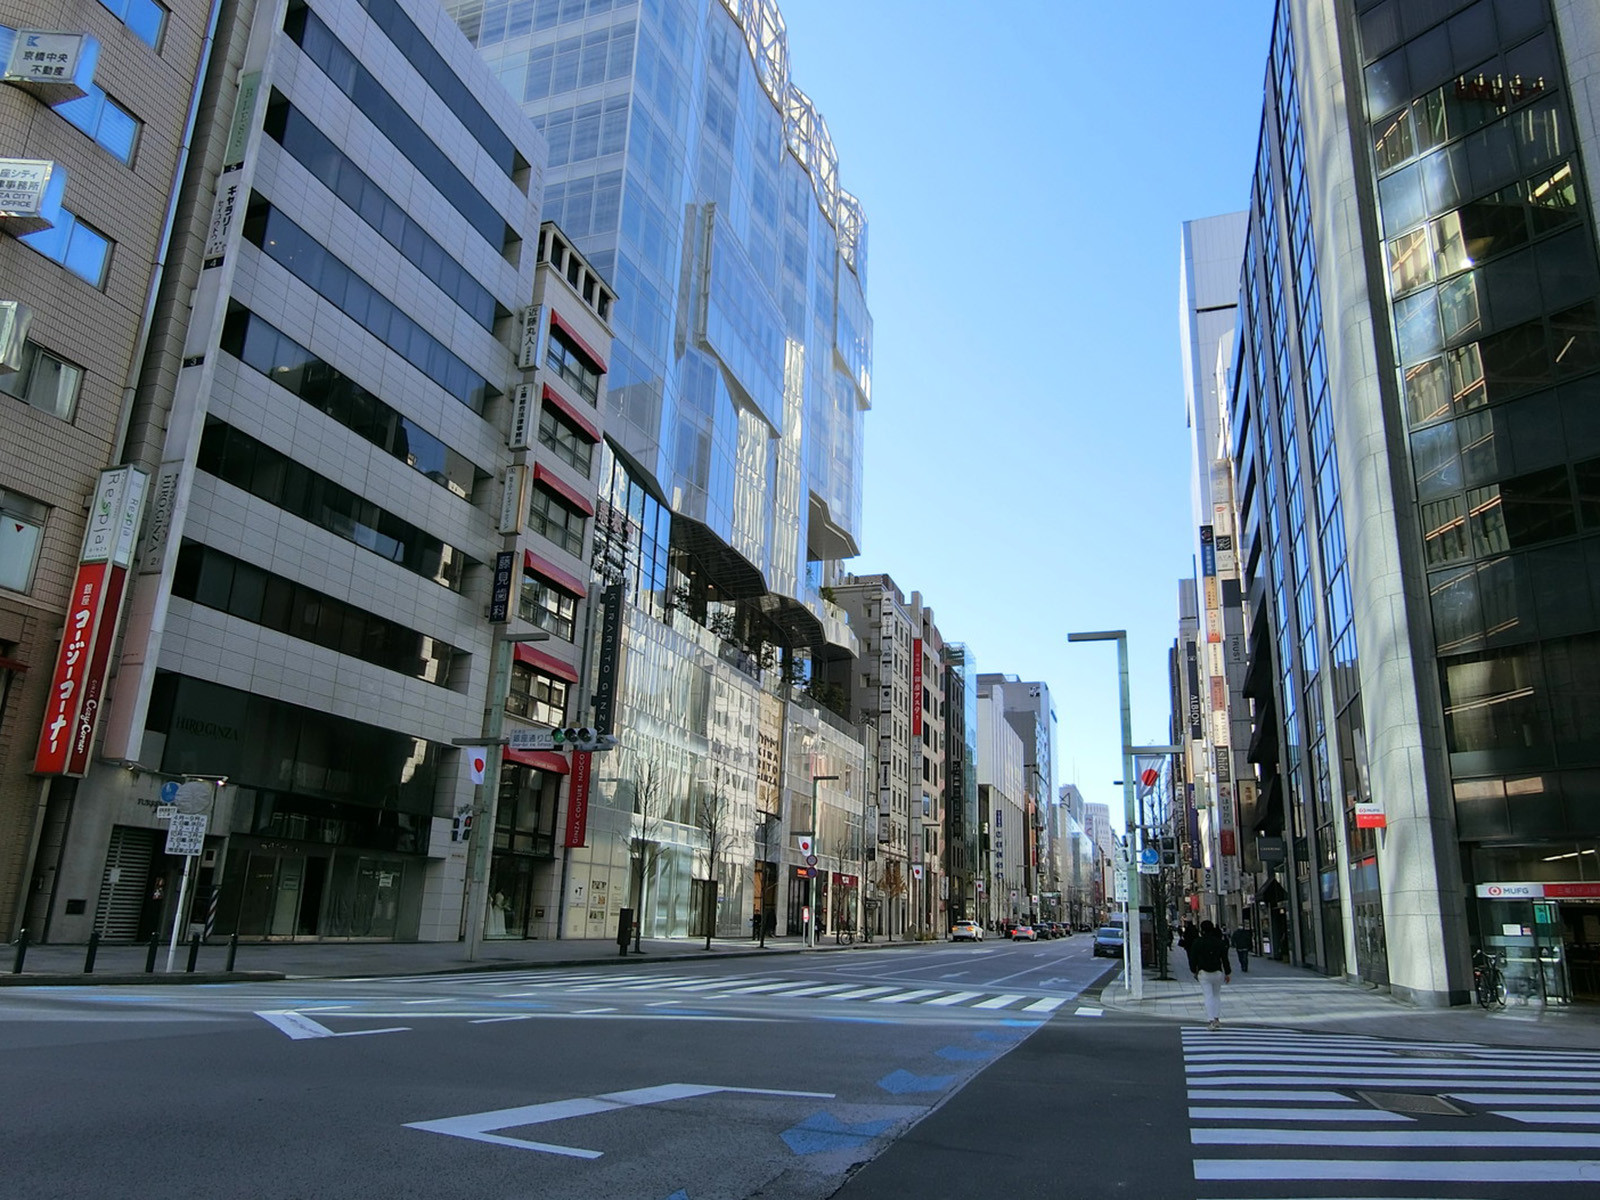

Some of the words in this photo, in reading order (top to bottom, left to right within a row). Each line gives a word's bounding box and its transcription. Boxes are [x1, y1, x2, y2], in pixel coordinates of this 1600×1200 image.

[23, 51, 68, 63] 京橋中央
[31, 65, 65, 76] 不動産
[1, 200, 31, 208] OFFICE
[525, 307, 538, 346] 近藤丸人
[158, 474, 172, 509] HIRO
[148, 509, 165, 553] GINZA
[603, 593, 616, 673] KIRARITO
[1232, 636, 1240, 661] TRUST
[48, 609, 90, 754] コージーコーナー
[598, 682, 609, 734] GINZA
[1190, 694, 1200, 726] ALBION
[513, 734, 553, 743] 銀座通り口
[578, 753, 586, 782] NAOCO
[1218, 747, 1228, 777] Ishida
[575, 784, 583, 819] COUTURE
[572, 821, 580, 844] GINZA
[1503, 887, 1529, 895] MUFG
